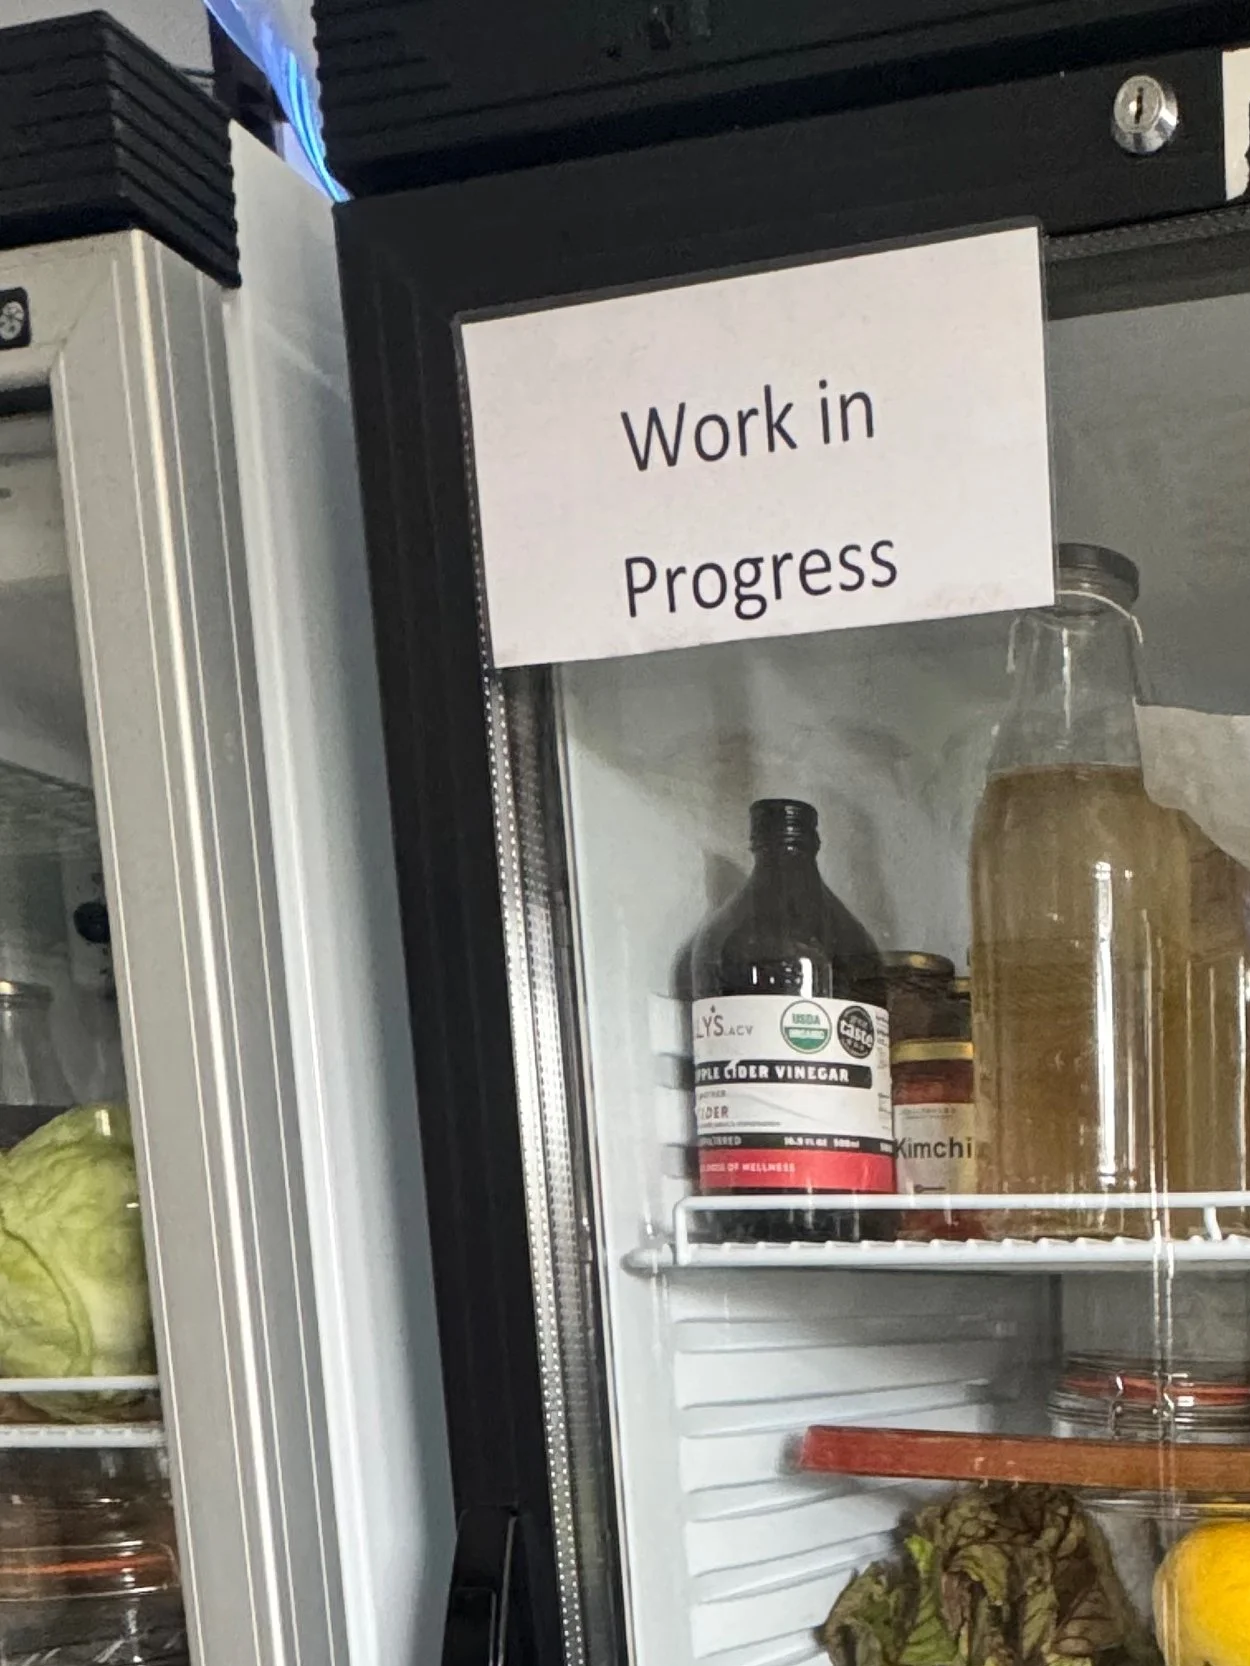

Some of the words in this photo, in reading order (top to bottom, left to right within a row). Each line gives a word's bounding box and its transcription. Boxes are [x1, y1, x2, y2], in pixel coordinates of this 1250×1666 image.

[620, 384, 798, 472] Work
[817, 378, 876, 445] in
[623, 538, 899, 621] Progress
[792, 1013, 821, 1025] USDA
[724, 1060, 769, 1081] CIDER
[775, 1064, 850, 1083] VINEGAR
[895, 1136, 972, 1159] Kimchi
